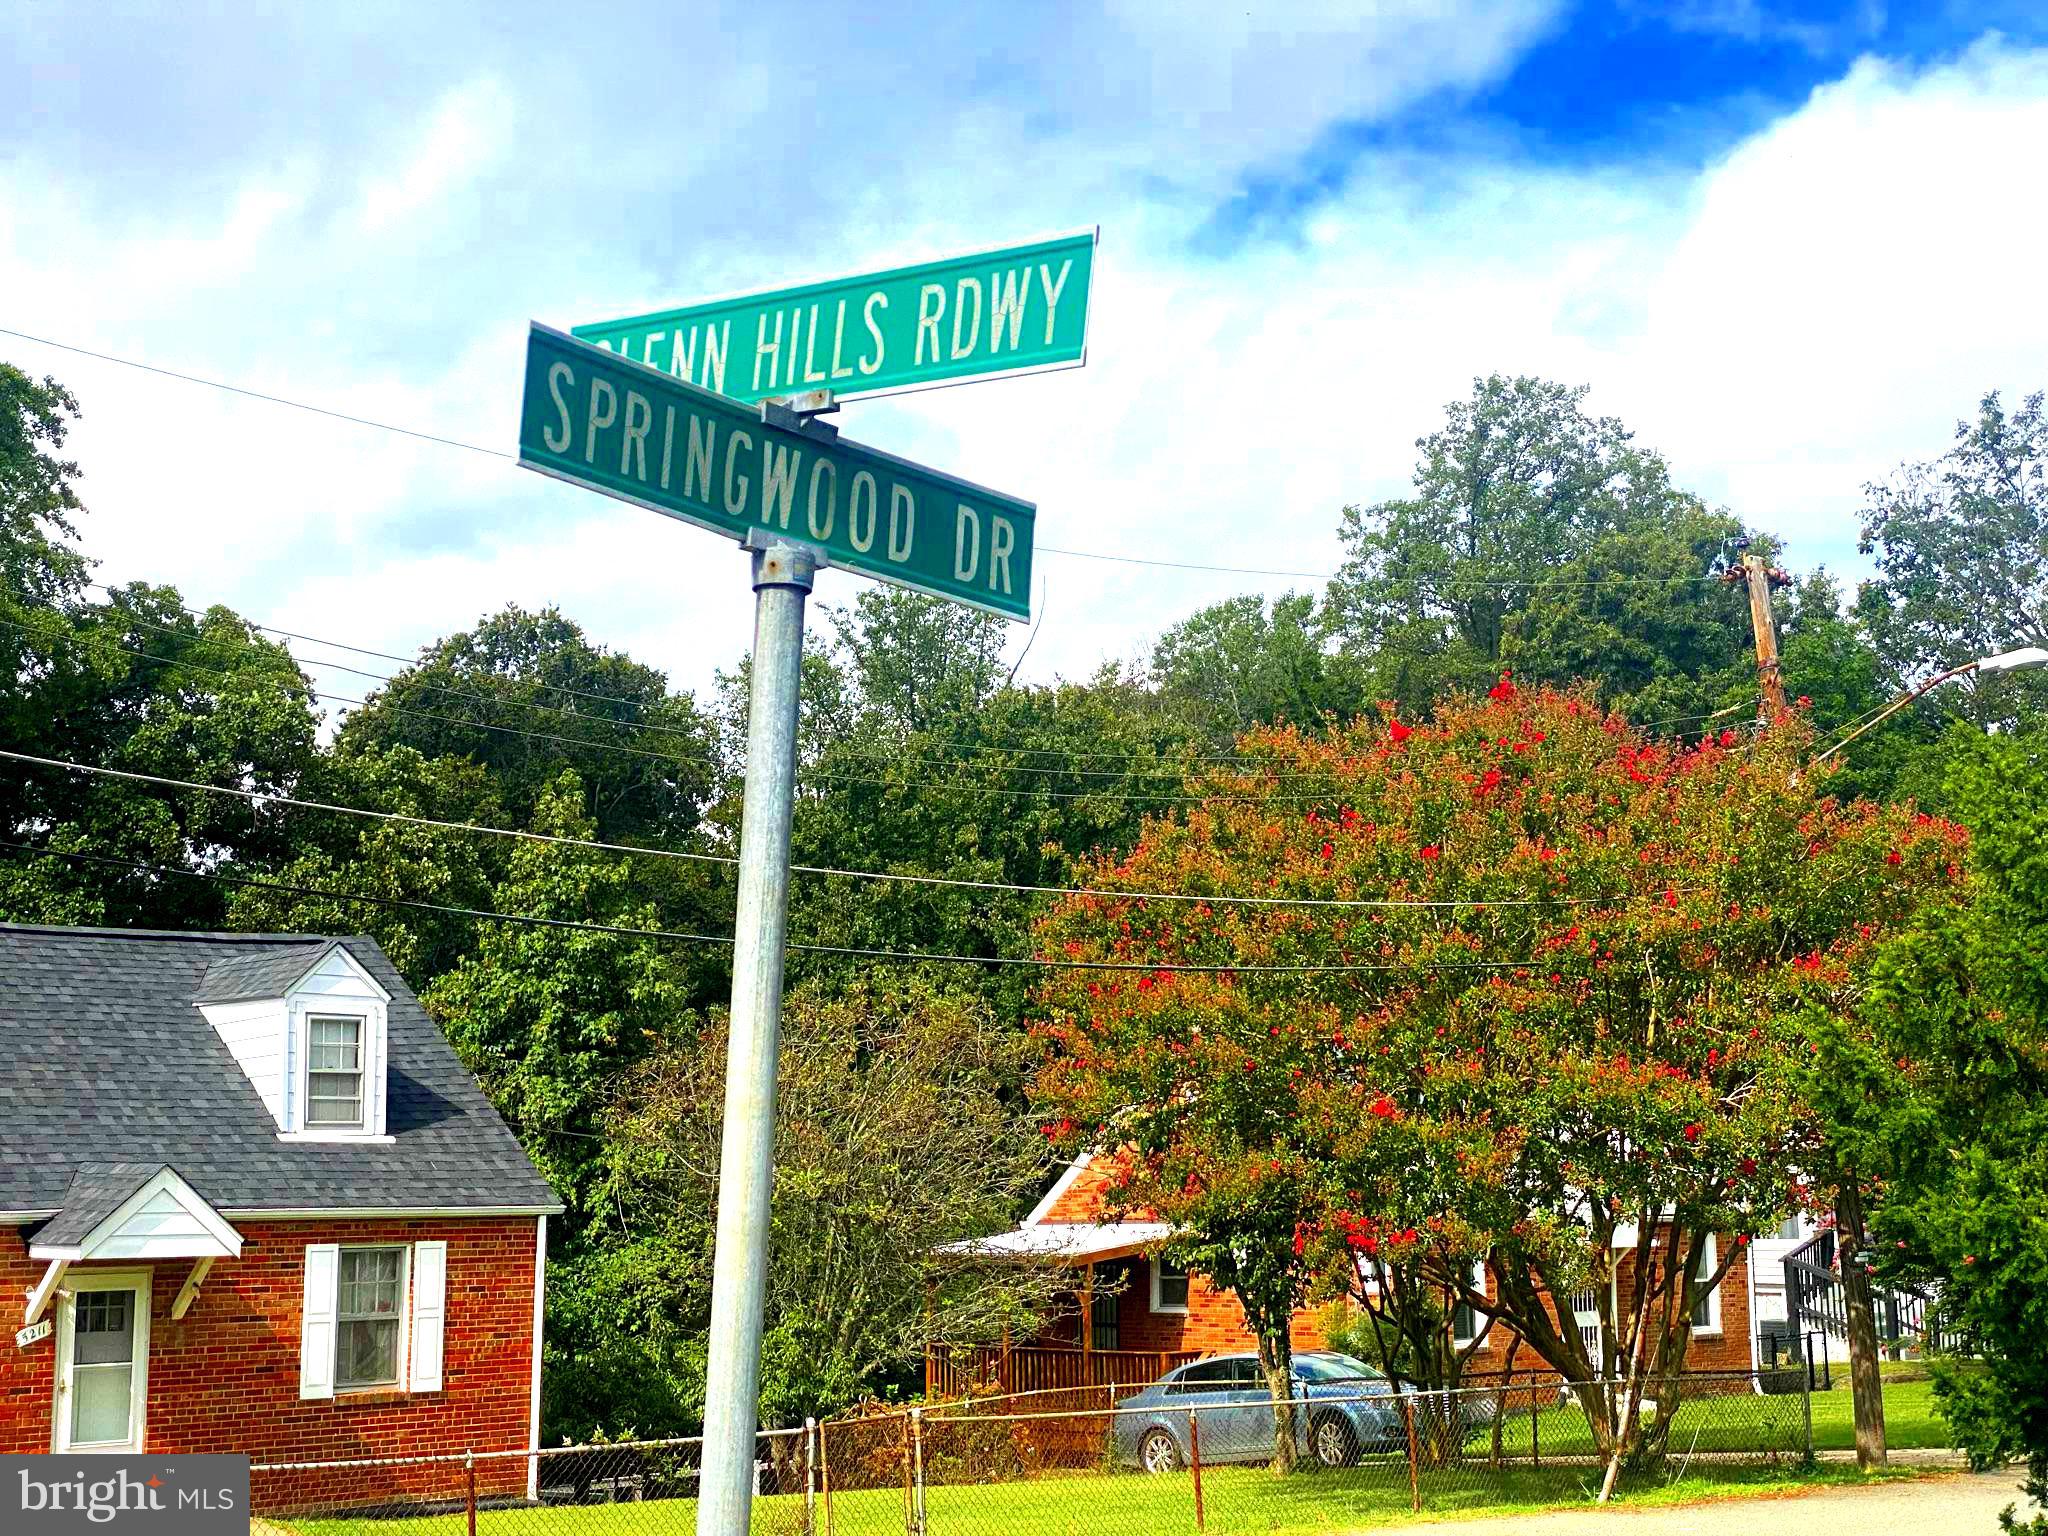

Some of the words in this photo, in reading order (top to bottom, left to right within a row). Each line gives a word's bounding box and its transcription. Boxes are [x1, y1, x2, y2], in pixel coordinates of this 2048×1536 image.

[752, 292, 889, 391] HILLS
[914, 259, 1073, 365] RDWY
[543, 361, 916, 564] SPRINGWOOD
[953, 503, 1015, 595] DR
